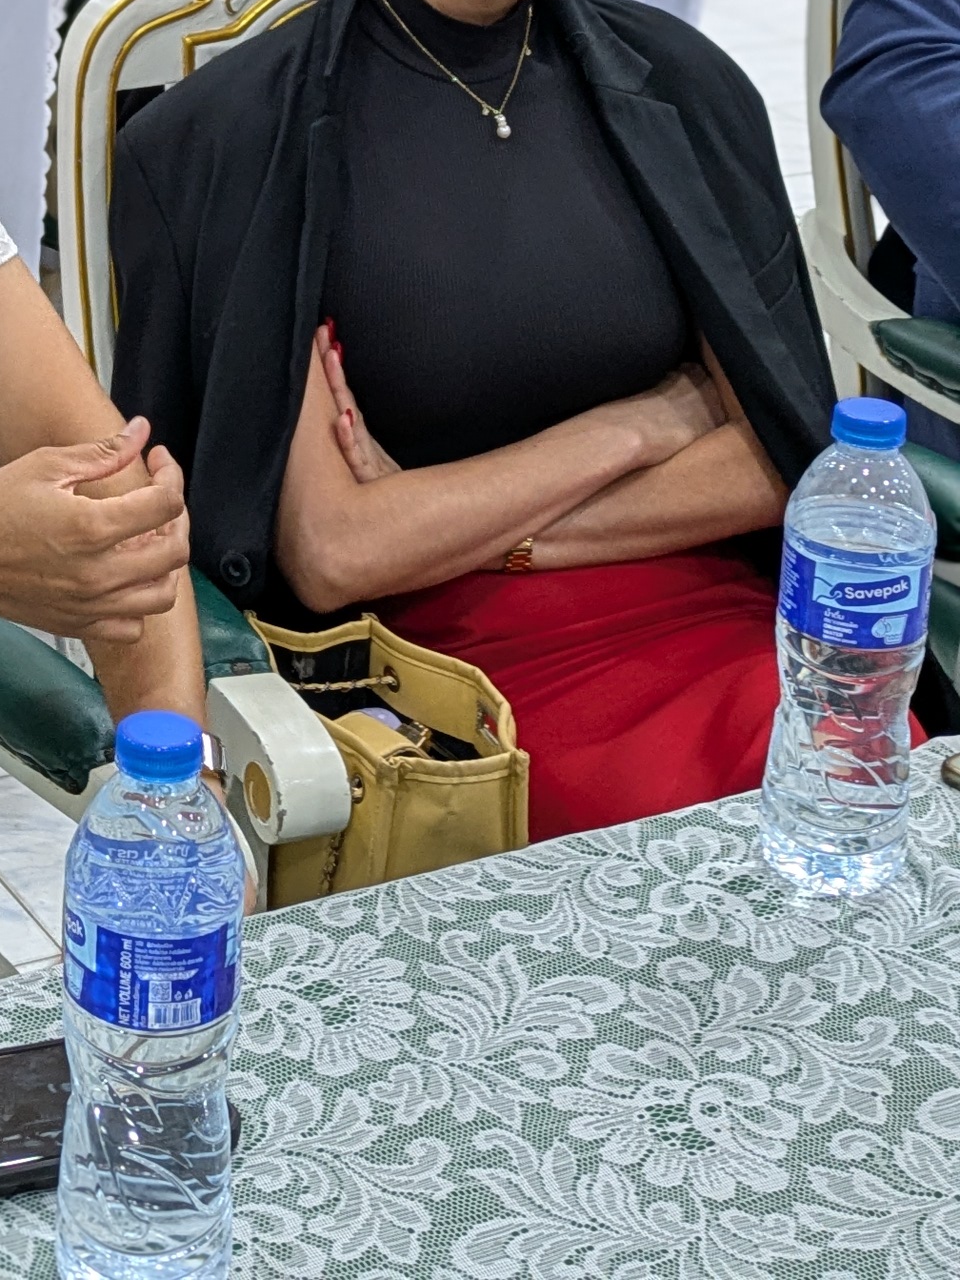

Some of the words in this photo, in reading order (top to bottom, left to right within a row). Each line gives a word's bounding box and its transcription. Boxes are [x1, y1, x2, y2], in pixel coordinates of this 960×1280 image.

[844, 579, 909, 600] Savepak
[121, 938, 133, 951] ml
[120, 951, 132, 970] 600
[119, 969, 132, 1006] VOLUME
[118, 1006, 131, 1026] NET
